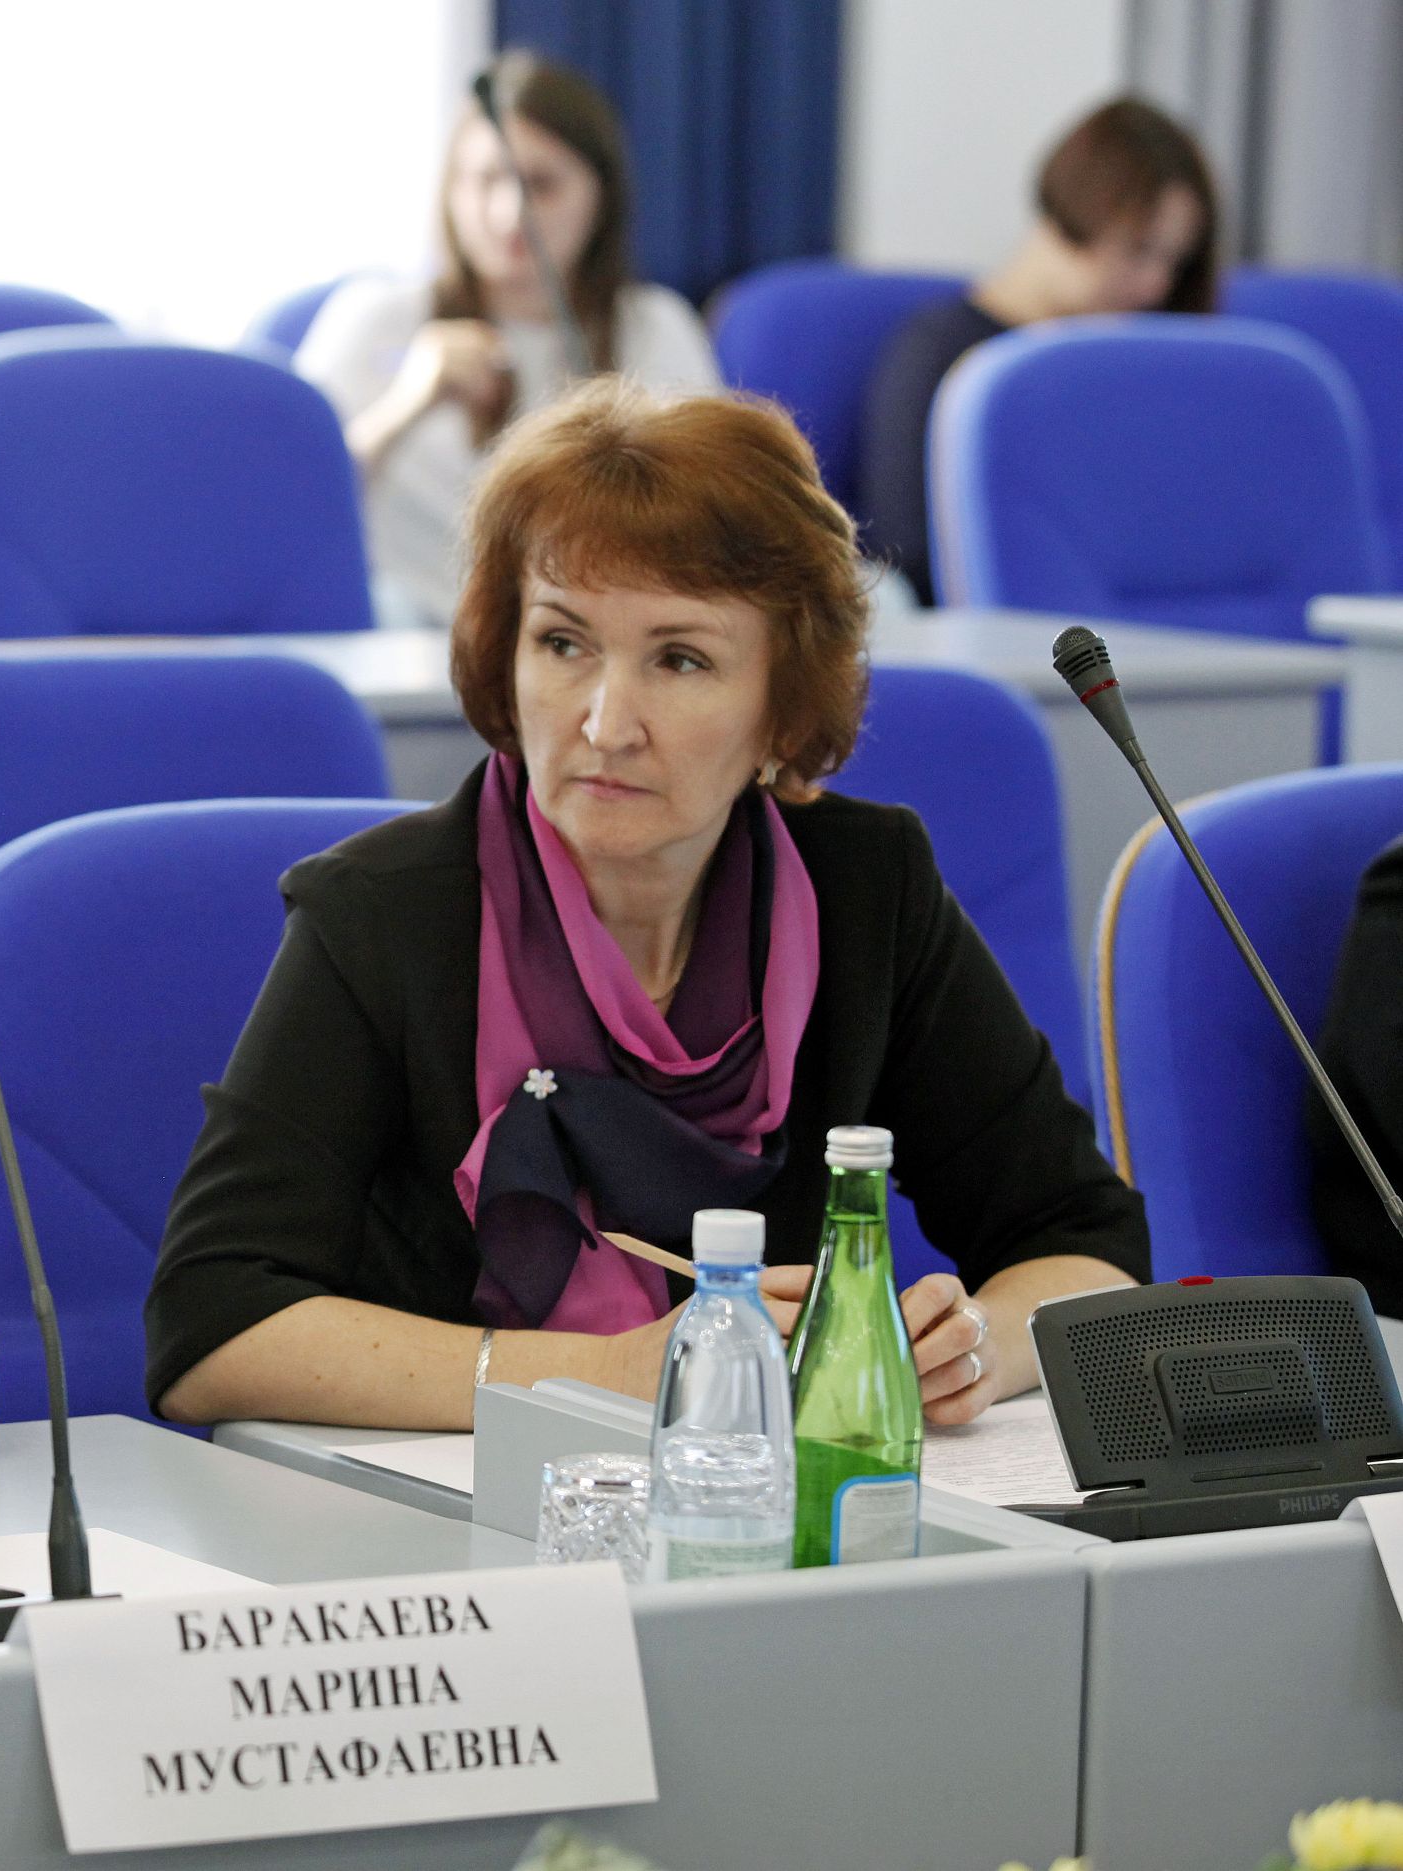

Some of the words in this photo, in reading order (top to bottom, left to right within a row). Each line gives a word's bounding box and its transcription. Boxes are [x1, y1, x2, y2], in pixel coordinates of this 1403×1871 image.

[1279, 1493, 1340, 1515] PHILIPS
[175, 1593, 493, 1653] БАРАКАЕВА
[228, 1663, 461, 1720] МАРИНА
[141, 1724, 561, 1796] МУСТАФАЕВНА
